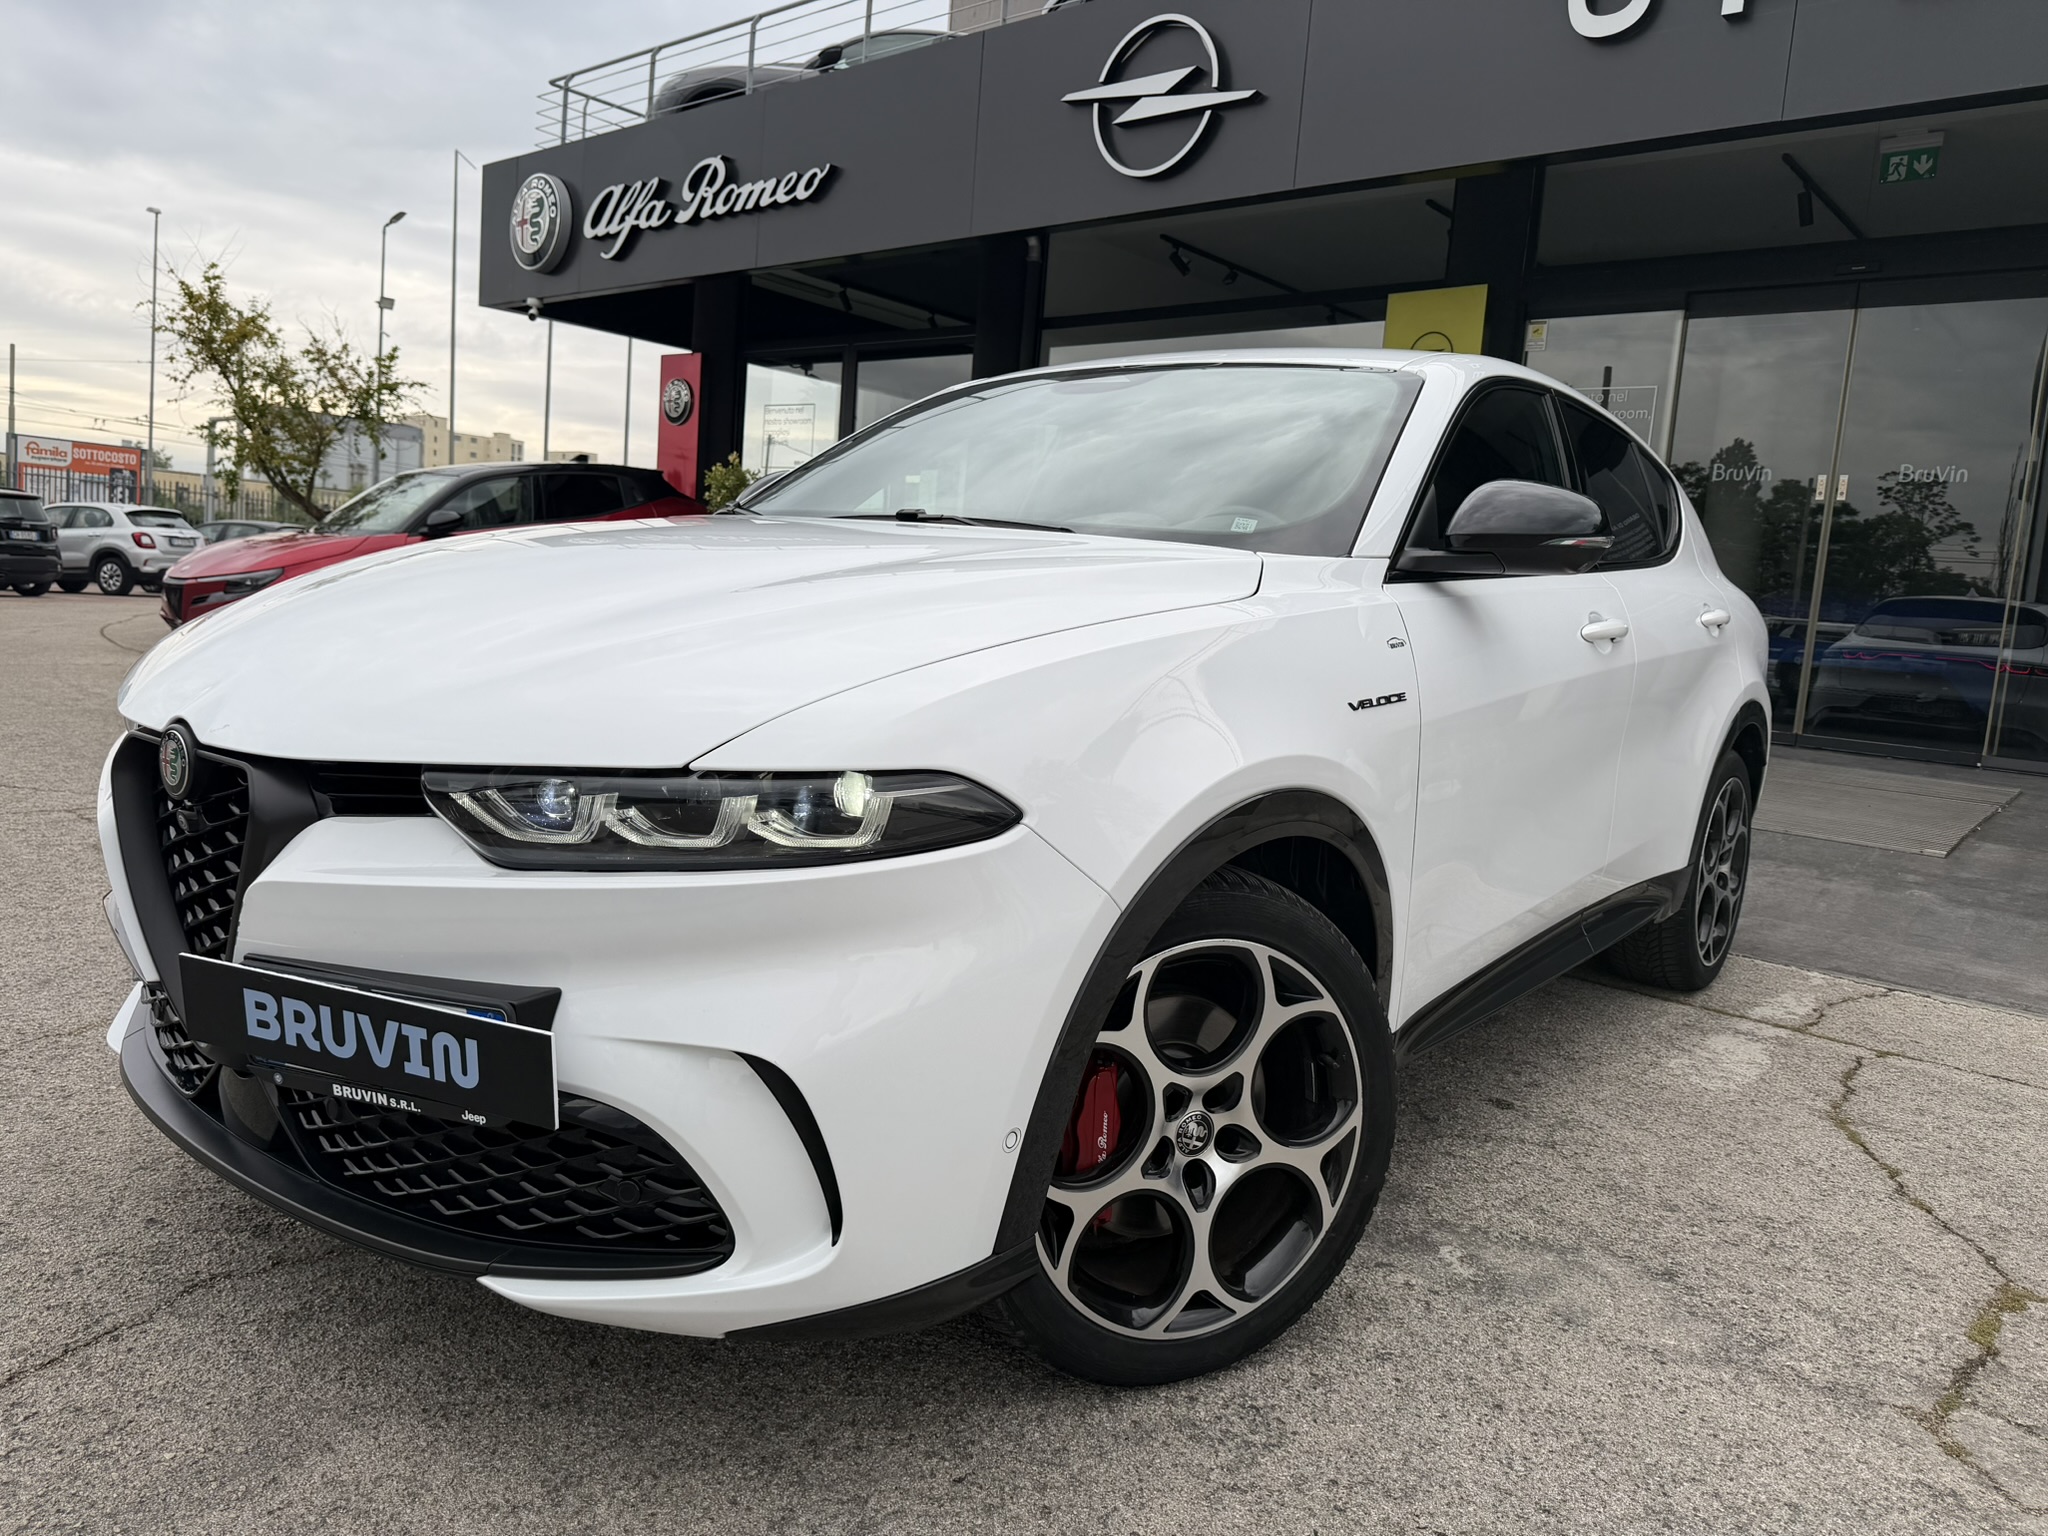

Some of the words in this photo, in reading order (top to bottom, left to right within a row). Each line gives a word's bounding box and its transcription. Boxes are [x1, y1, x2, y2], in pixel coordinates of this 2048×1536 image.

[531, 179, 557, 218] ROMEO
[583, 177, 671, 260] Alfa
[674, 155, 830, 225] Romeo
[1608, 389, 1629, 402] nel
[24, 441, 68, 458] famila
[73, 447, 137, 465] SOTTOCOSTO
[1712, 463, 1772, 481] BruVin
[1899, 464, 1968, 482] BruVin
[1347, 692, 1407, 711] VELOCE
[243, 987, 480, 1089] BRUVIN
[332, 1083, 388, 1106] BRUVIN
[389, 1097, 421, 1112] S.R.L.
[461, 1110, 486, 1125] Jeep
[1178, 1114, 1202, 1134] ROMEO
[1097, 1110, 1108, 1149] Romeo
